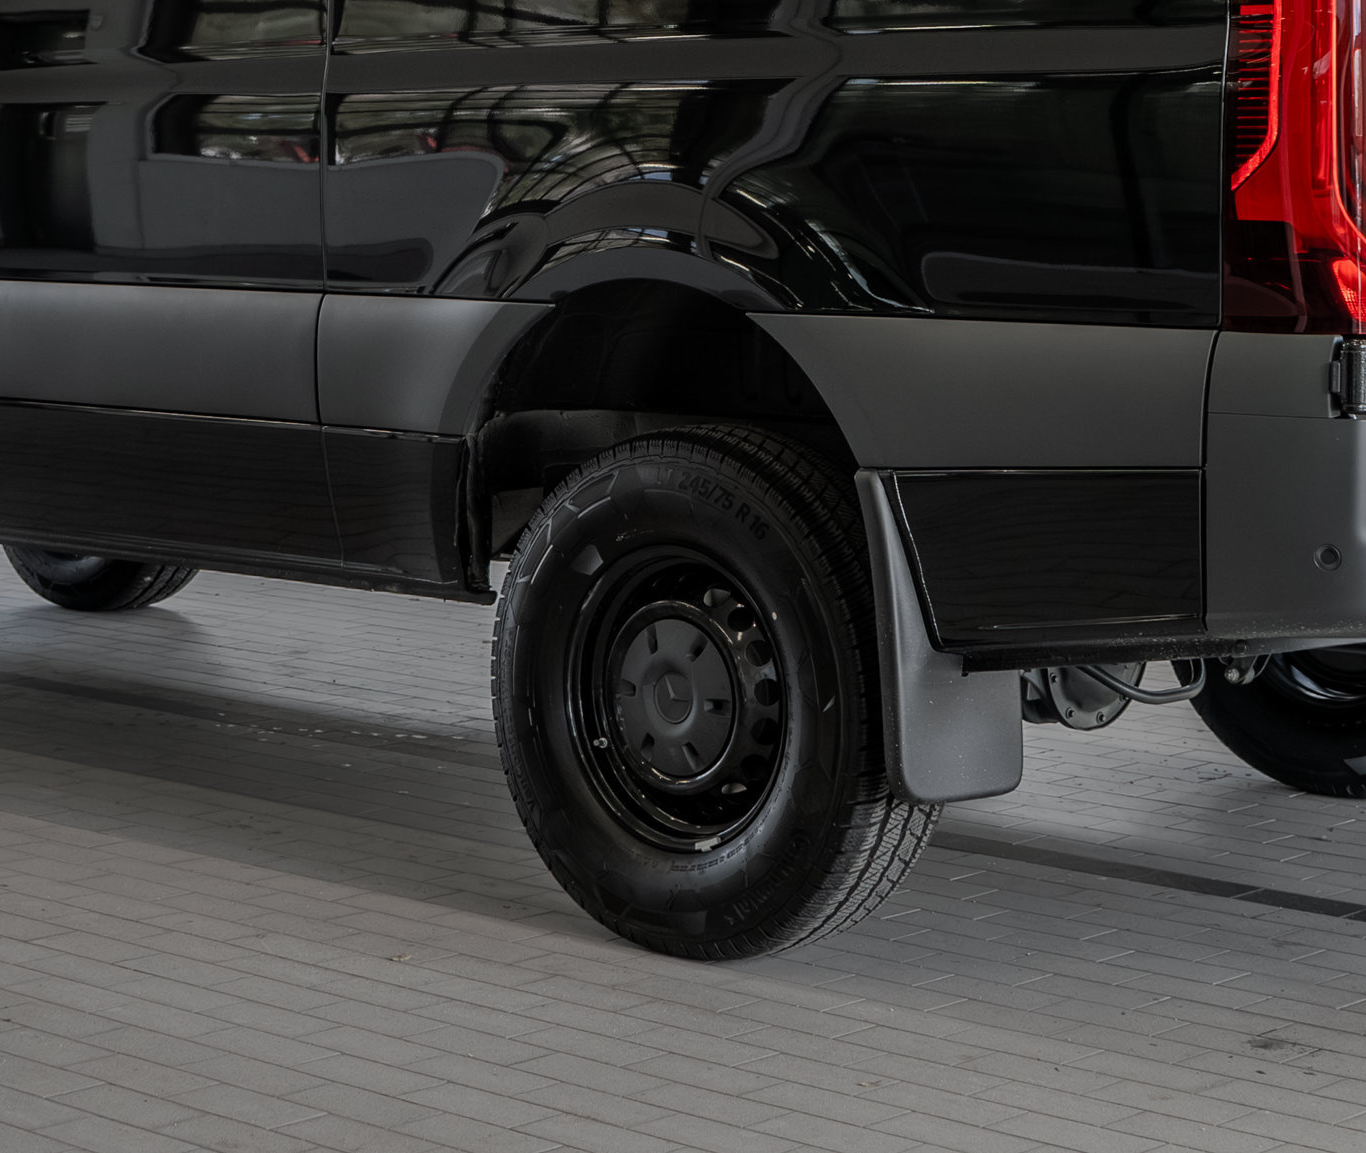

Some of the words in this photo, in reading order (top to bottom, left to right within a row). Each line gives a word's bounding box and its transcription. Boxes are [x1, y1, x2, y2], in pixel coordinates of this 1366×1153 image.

[678, 471, 736, 510] 245/75
[735, 502, 751, 523] R
[749, 514, 770, 540] 16
